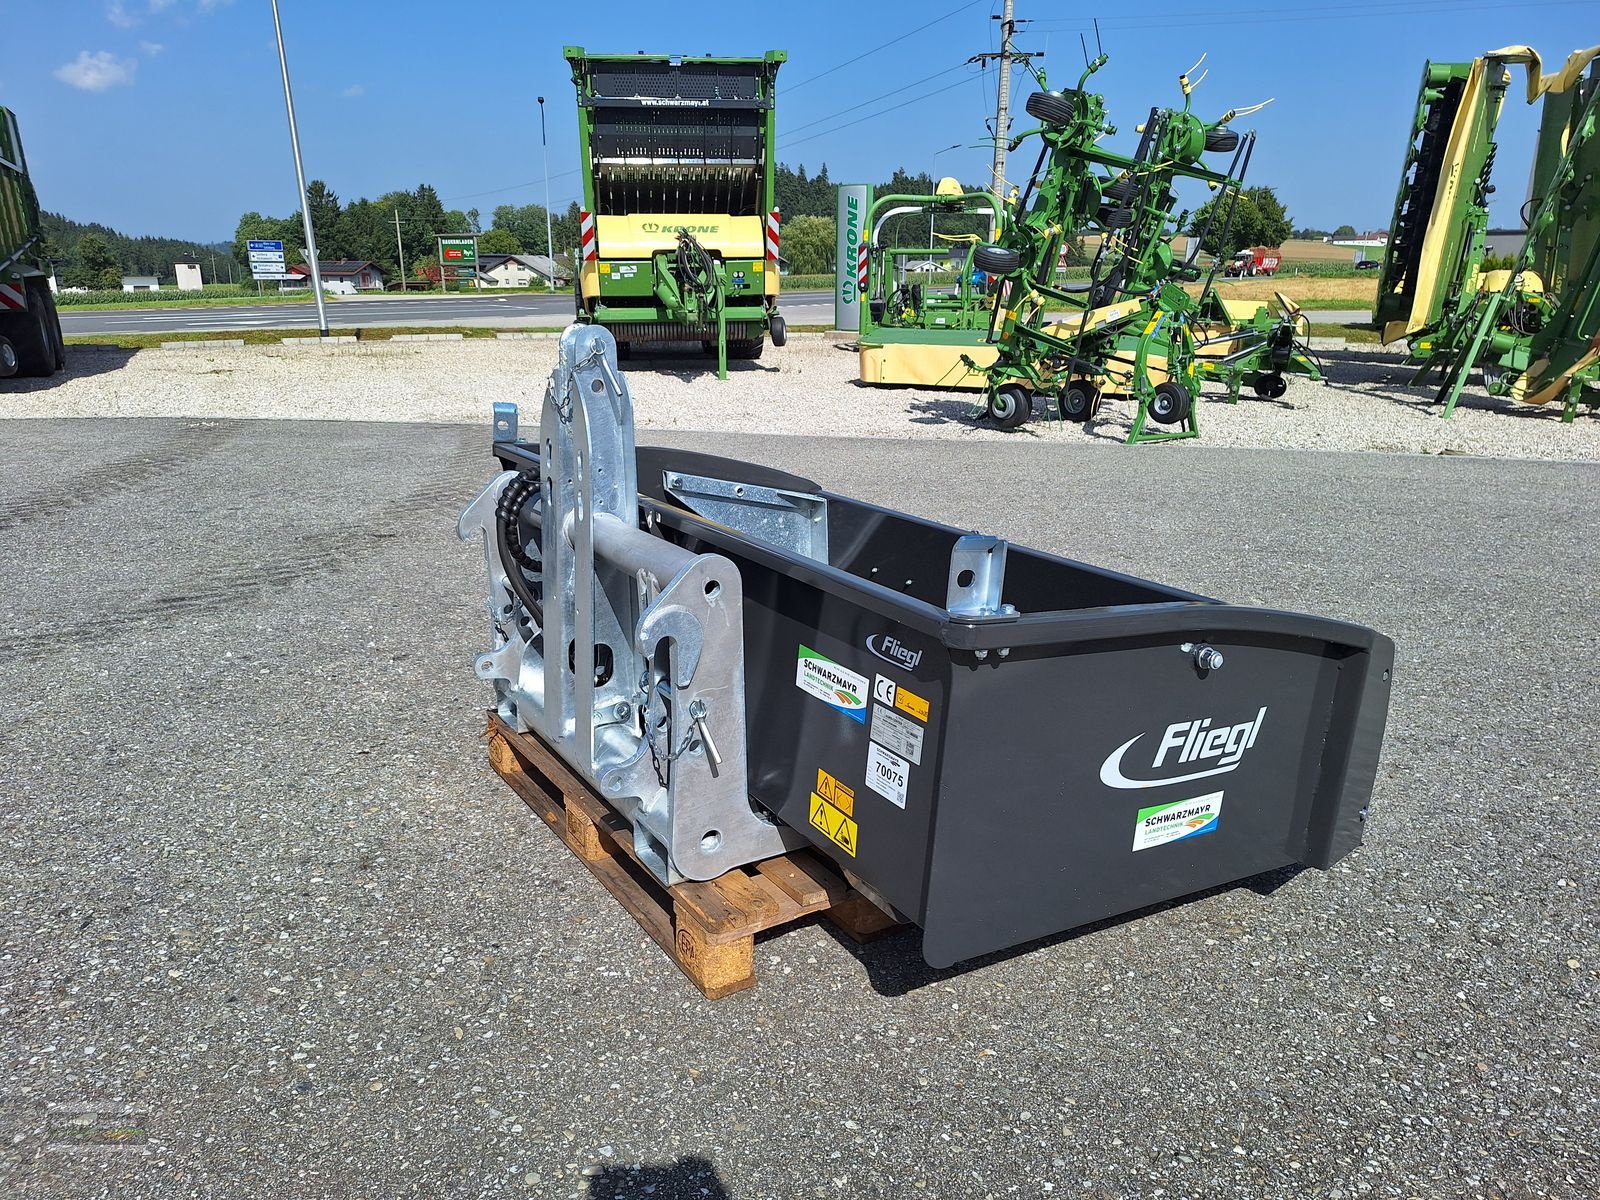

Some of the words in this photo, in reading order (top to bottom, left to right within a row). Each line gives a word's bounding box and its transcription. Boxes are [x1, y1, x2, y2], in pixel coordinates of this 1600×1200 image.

[661, 225, 719, 233] KRONE
[847, 196, 858, 278] KRONE
[881, 635, 923, 667] Fliegl
[803, 659, 858, 694] SCHWARZMAYR
[804, 670, 834, 691] LANDTECHNIK
[1152, 706, 1268, 768] Fliegl
[876, 761, 904, 788] 70075
[1145, 804, 1211, 827] SCHWARZMAYR
[1145, 822, 1184, 835] LANDTECHNIK
